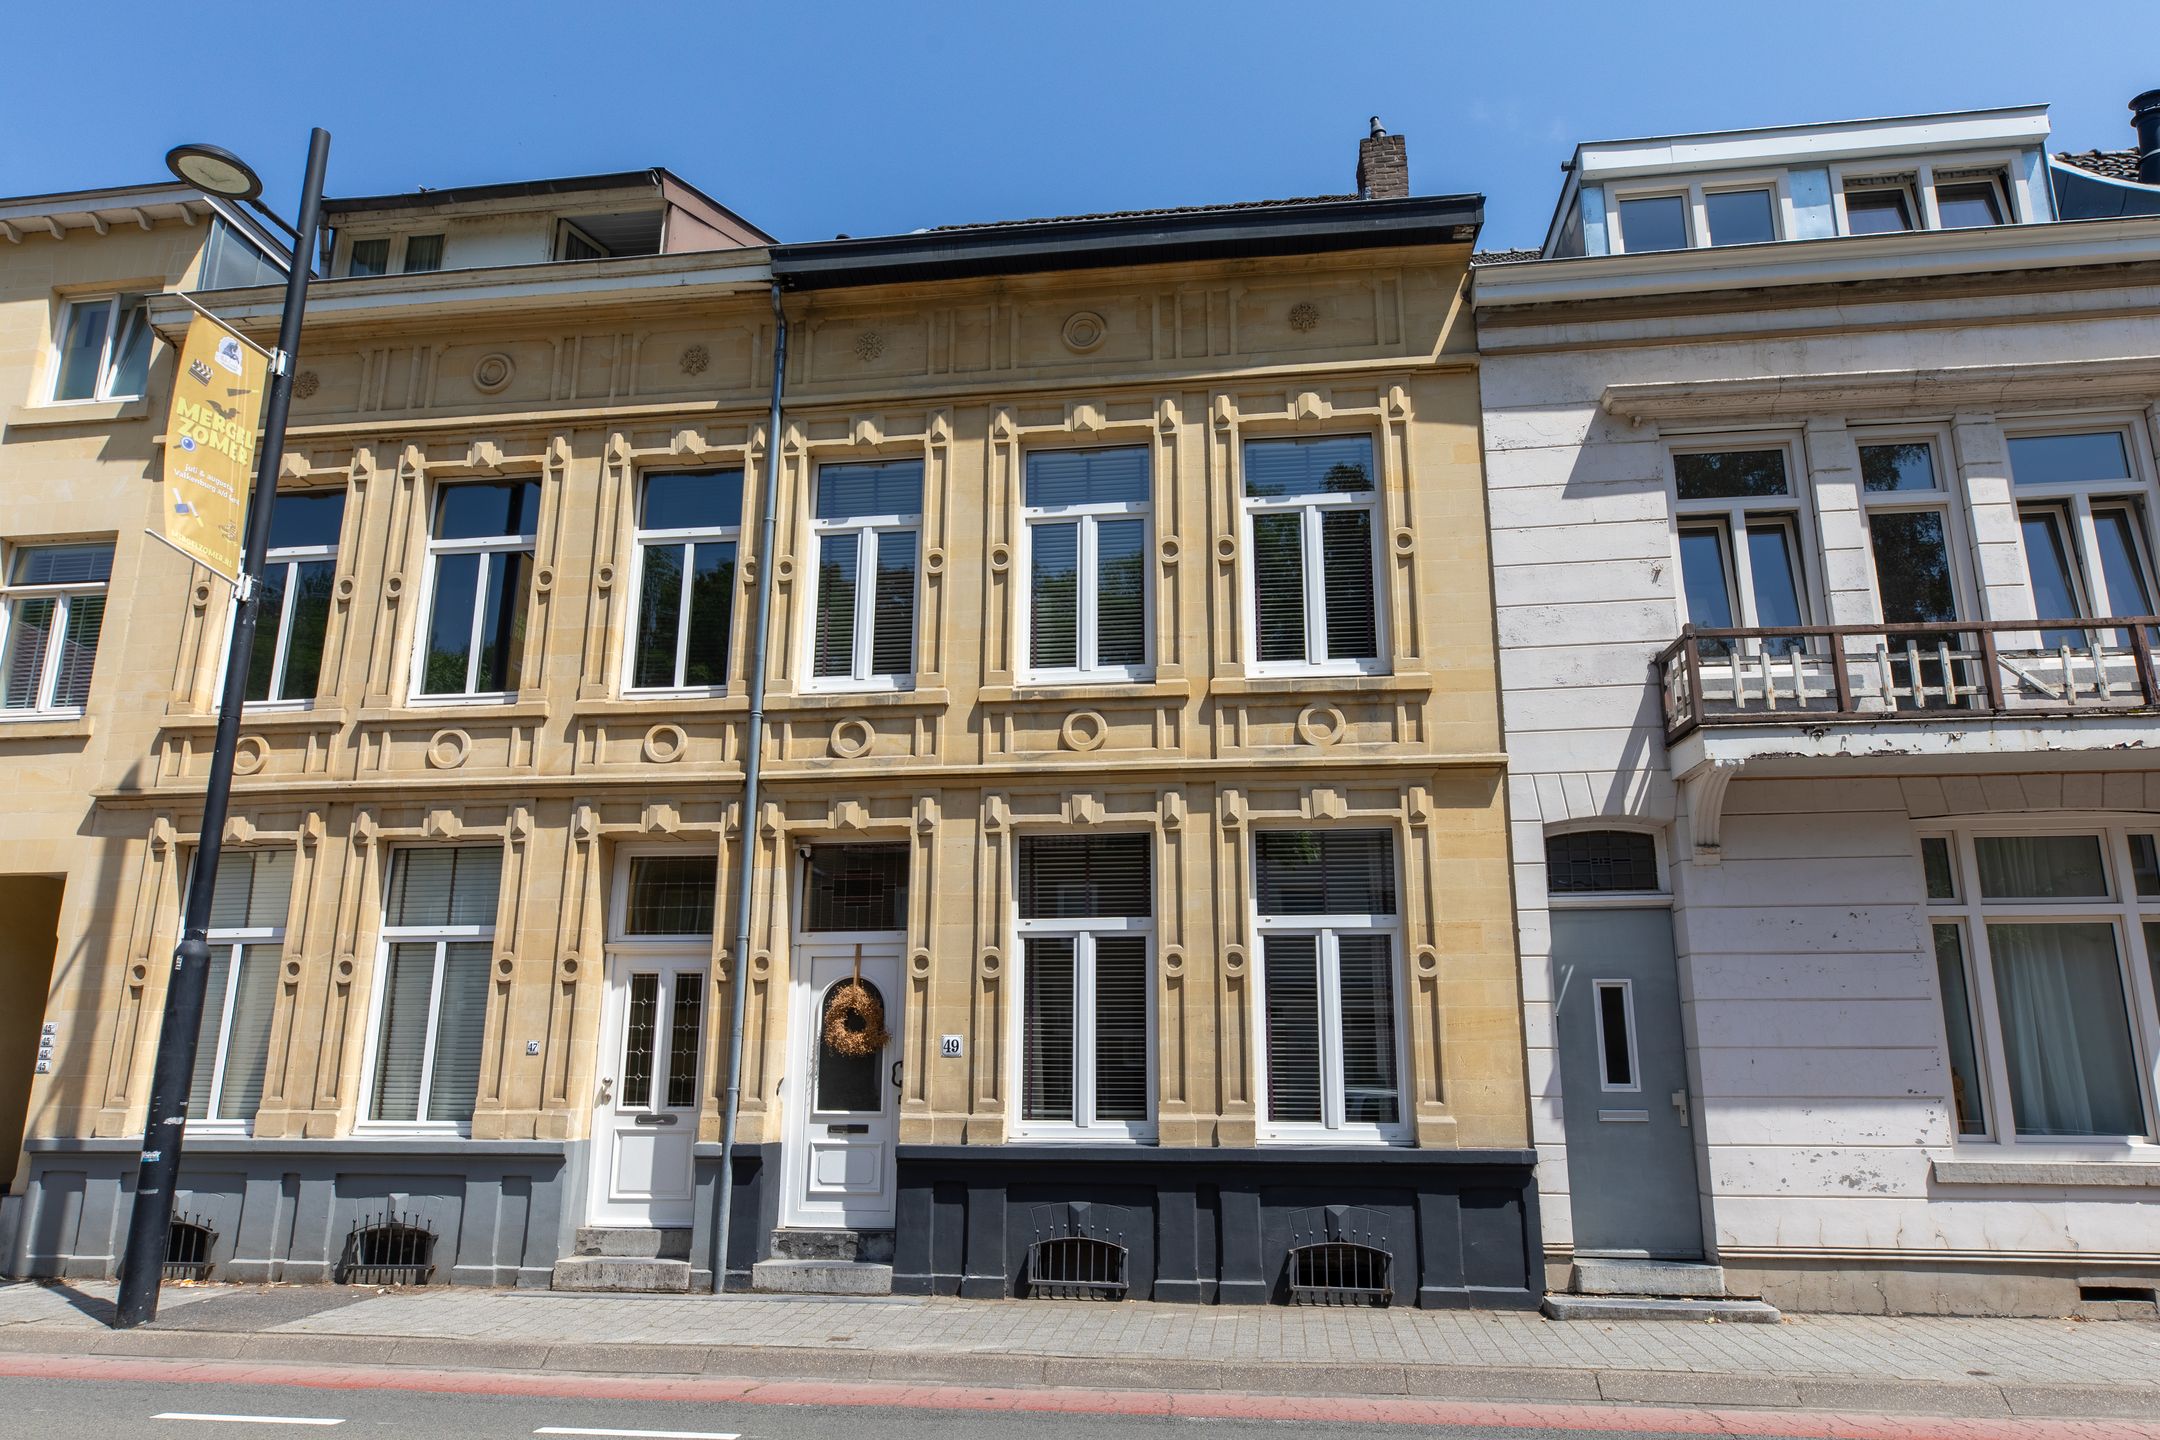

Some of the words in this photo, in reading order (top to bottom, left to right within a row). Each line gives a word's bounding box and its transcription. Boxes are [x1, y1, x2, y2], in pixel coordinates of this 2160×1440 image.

[176, 396, 253, 450] MERGEL
[177, 415, 248, 466] ZOMER
[174, 468, 217, 493] Valkenburg
[527, 1042, 538, 1051] 47
[943, 1039, 960, 1053] 49
